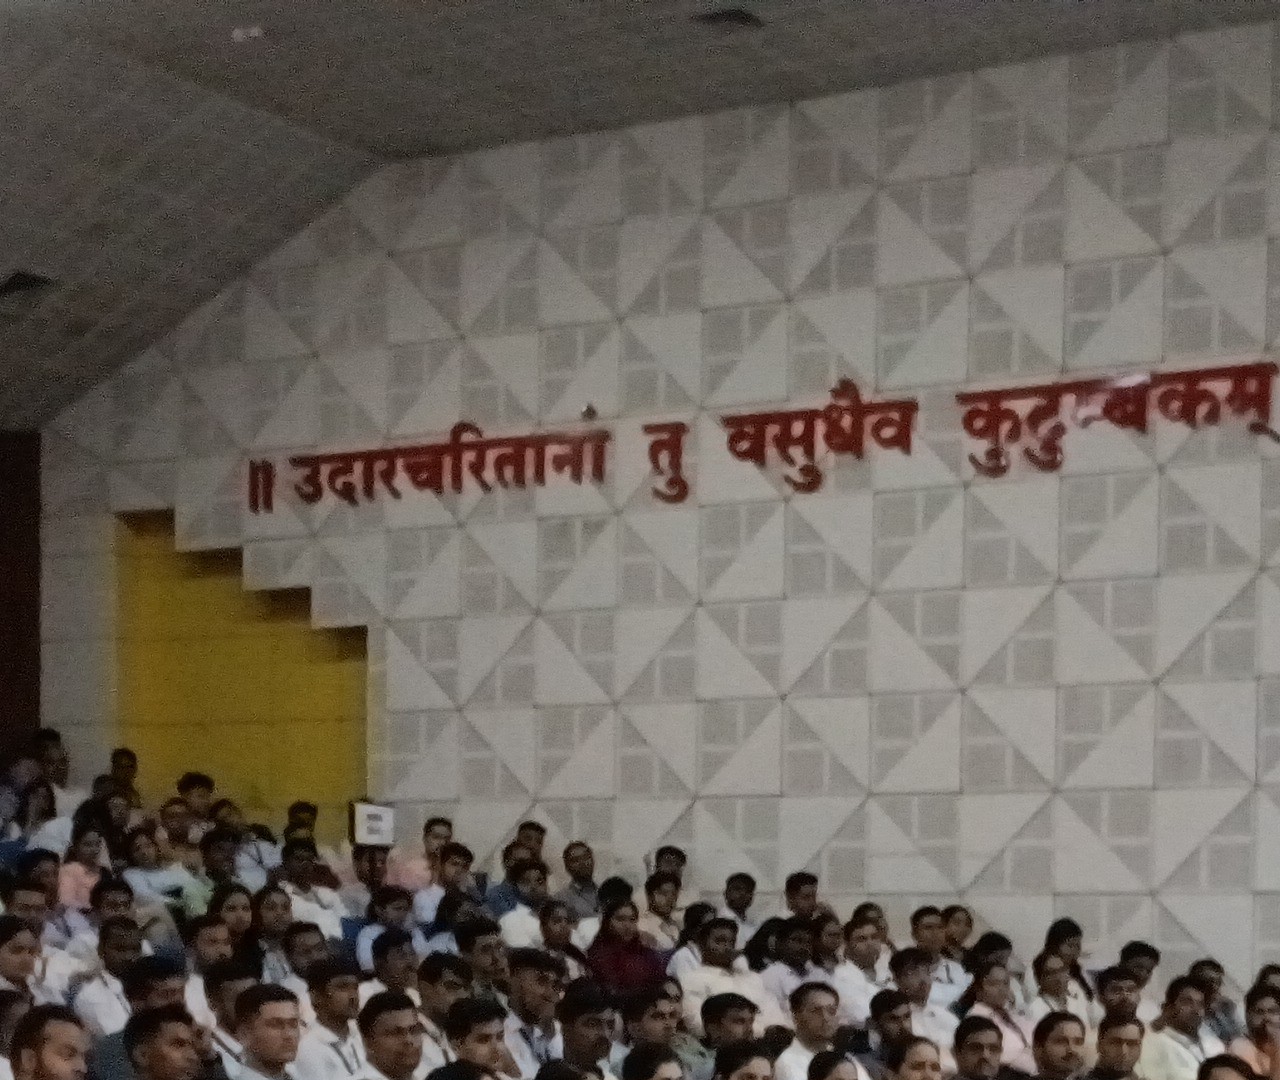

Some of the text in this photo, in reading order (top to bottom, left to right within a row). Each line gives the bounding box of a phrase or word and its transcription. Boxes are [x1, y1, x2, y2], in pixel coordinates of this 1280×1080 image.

[288, 402, 612, 507] उदारचरितानां
[642, 421, 690, 505] तु
[721, 376, 919, 494] वसुधैव
